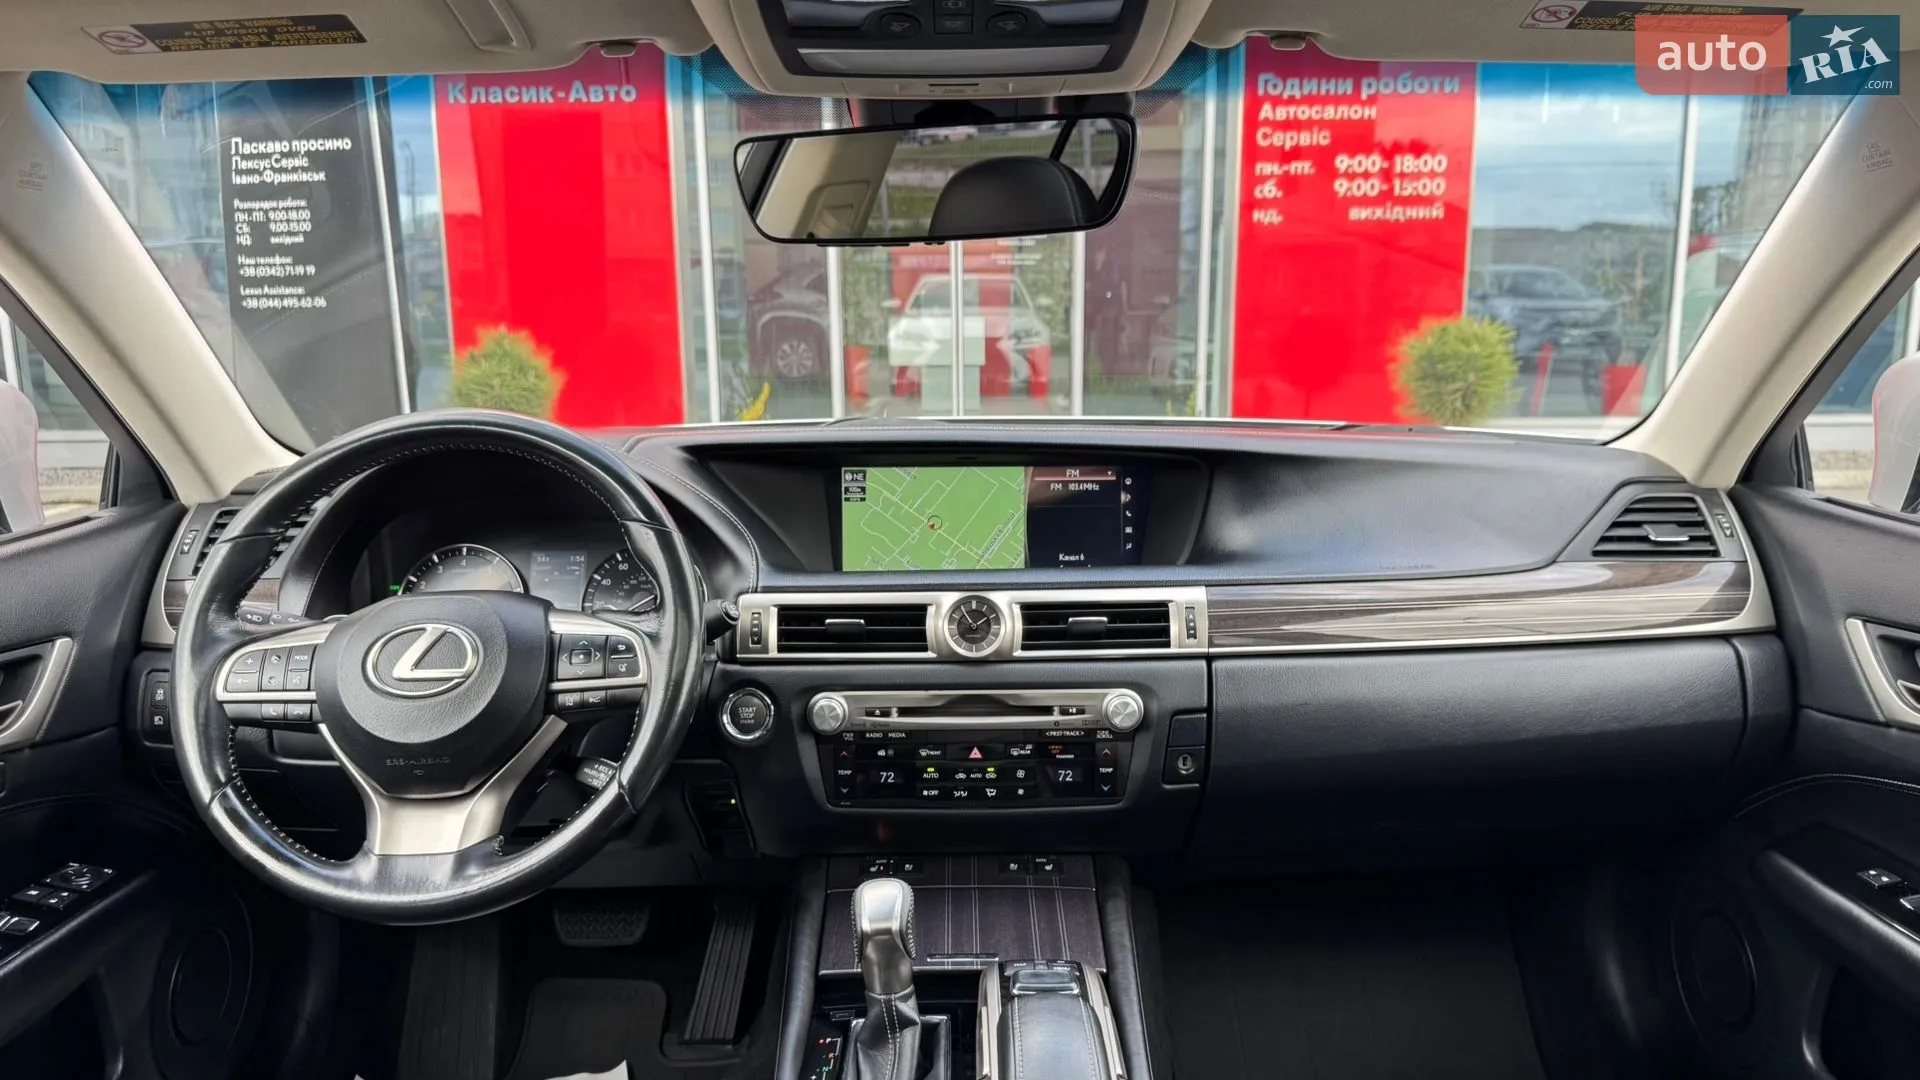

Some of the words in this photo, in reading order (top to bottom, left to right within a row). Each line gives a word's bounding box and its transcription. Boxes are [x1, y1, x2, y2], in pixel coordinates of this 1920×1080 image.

[225, 27, 268, 35] VISOR
[1257, 72, 1354, 99] Години
[1361, 71, 1460, 100] роботи
[448, 80, 637, 104] Класик-Авто
[1259, 102, 1377, 120] Автосалон
[1256, 127, 1331, 151] Сервіс
[291, 137, 352, 155] просимо
[271, 154, 309, 170] Сервіс
[231, 169, 327, 185] Івано-Франківськ
[1254, 180, 1283, 199] сб.
[1348, 202, 1445, 222] вихідний
[237, 254, 256, 265] Наш
[239, 266, 256, 277] +38
[256, 265, 285, 278] (0342)
[240, 284, 262, 296] Lexus
[240, 297, 258, 309] +38
[258, 297, 281, 310] (044)
[853, 473, 864, 481] NE
[1066, 469, 1080, 478] FM
[1050, 482, 1062, 491] FM
[1059, 552, 1079, 561] Канал
[437, 565, 443, 574] 3
[618, 563, 629, 571] 60
[420, 581, 426, 589] 2
[601, 578, 611, 586] 40
[738, 706, 756, 714] START
[880, 771, 895, 784] 72
[1058, 770, 1073, 782] 72
